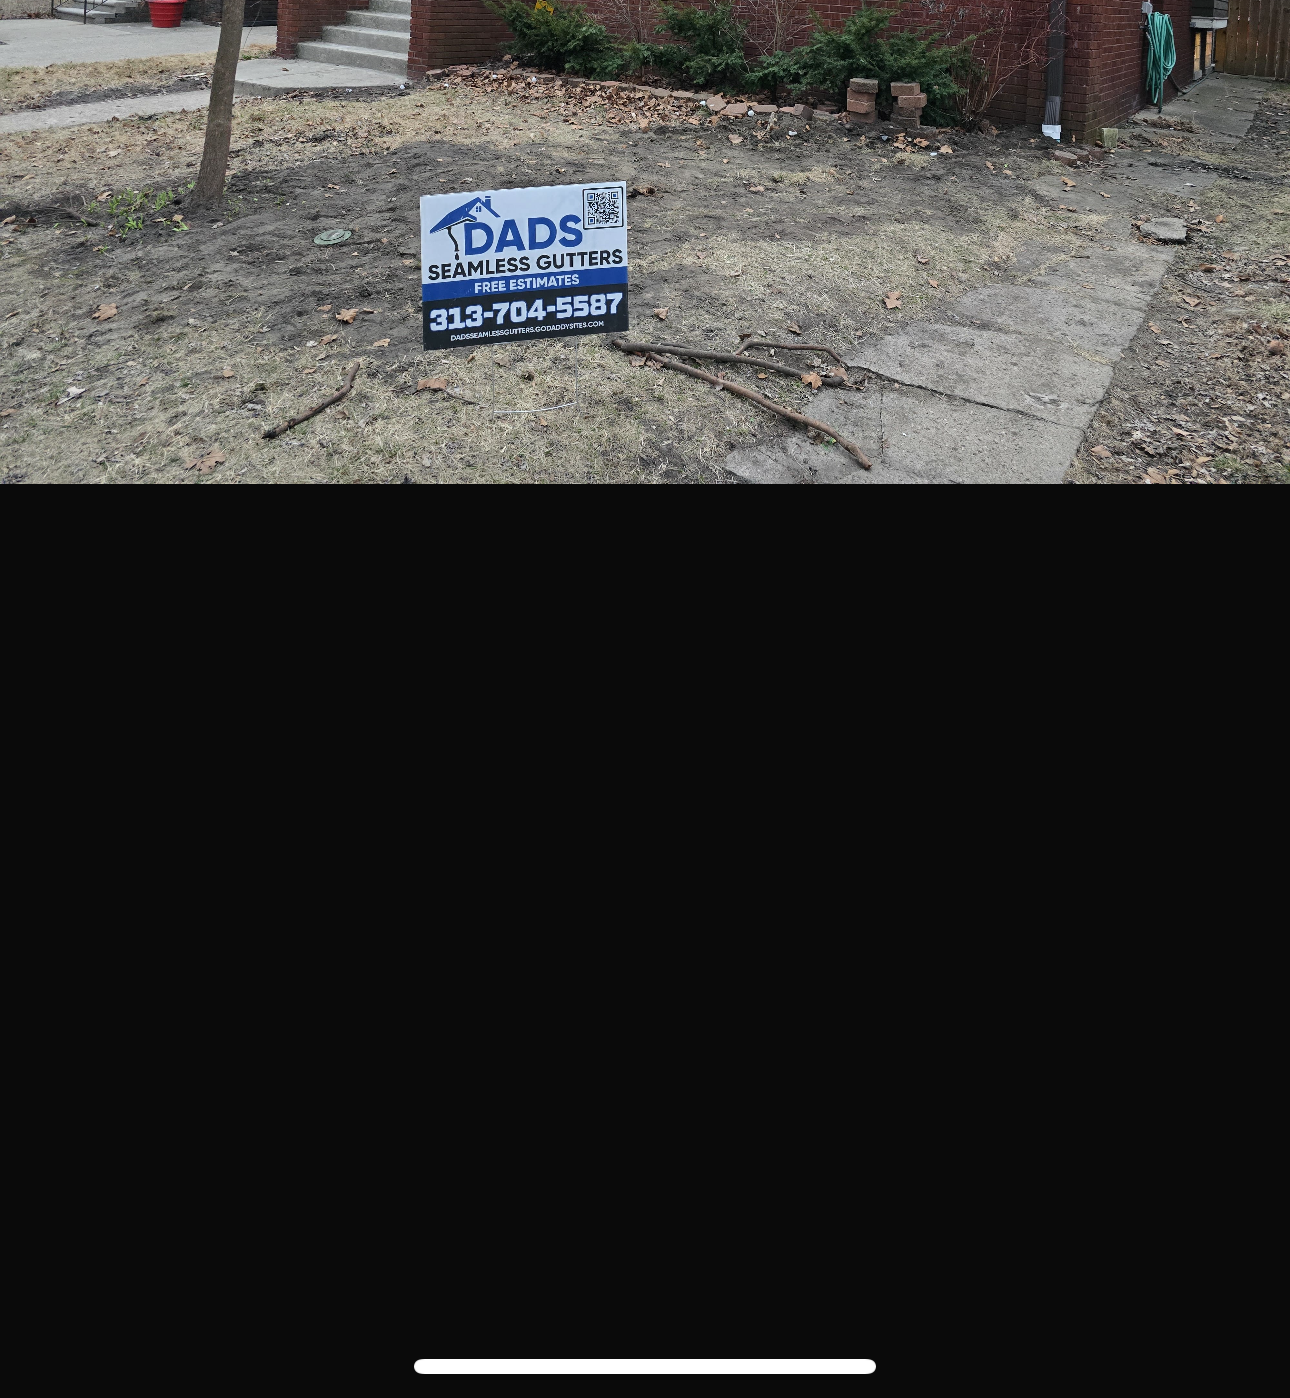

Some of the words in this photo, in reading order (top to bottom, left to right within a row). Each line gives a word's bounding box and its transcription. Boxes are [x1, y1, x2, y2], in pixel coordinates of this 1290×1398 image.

[464, 214, 583, 256] DADS
[428, 256, 530, 281] SEAMLESS
[537, 249, 623, 270] GUTTERS
[474, 280, 505, 293] FREE
[510, 274, 579, 290] ESTIMATES
[430, 292, 623, 331] 313-704-5587
[451, 320, 604, 341] DADSSEAMLESSGUTTERS.GODADDYSITES.COM
